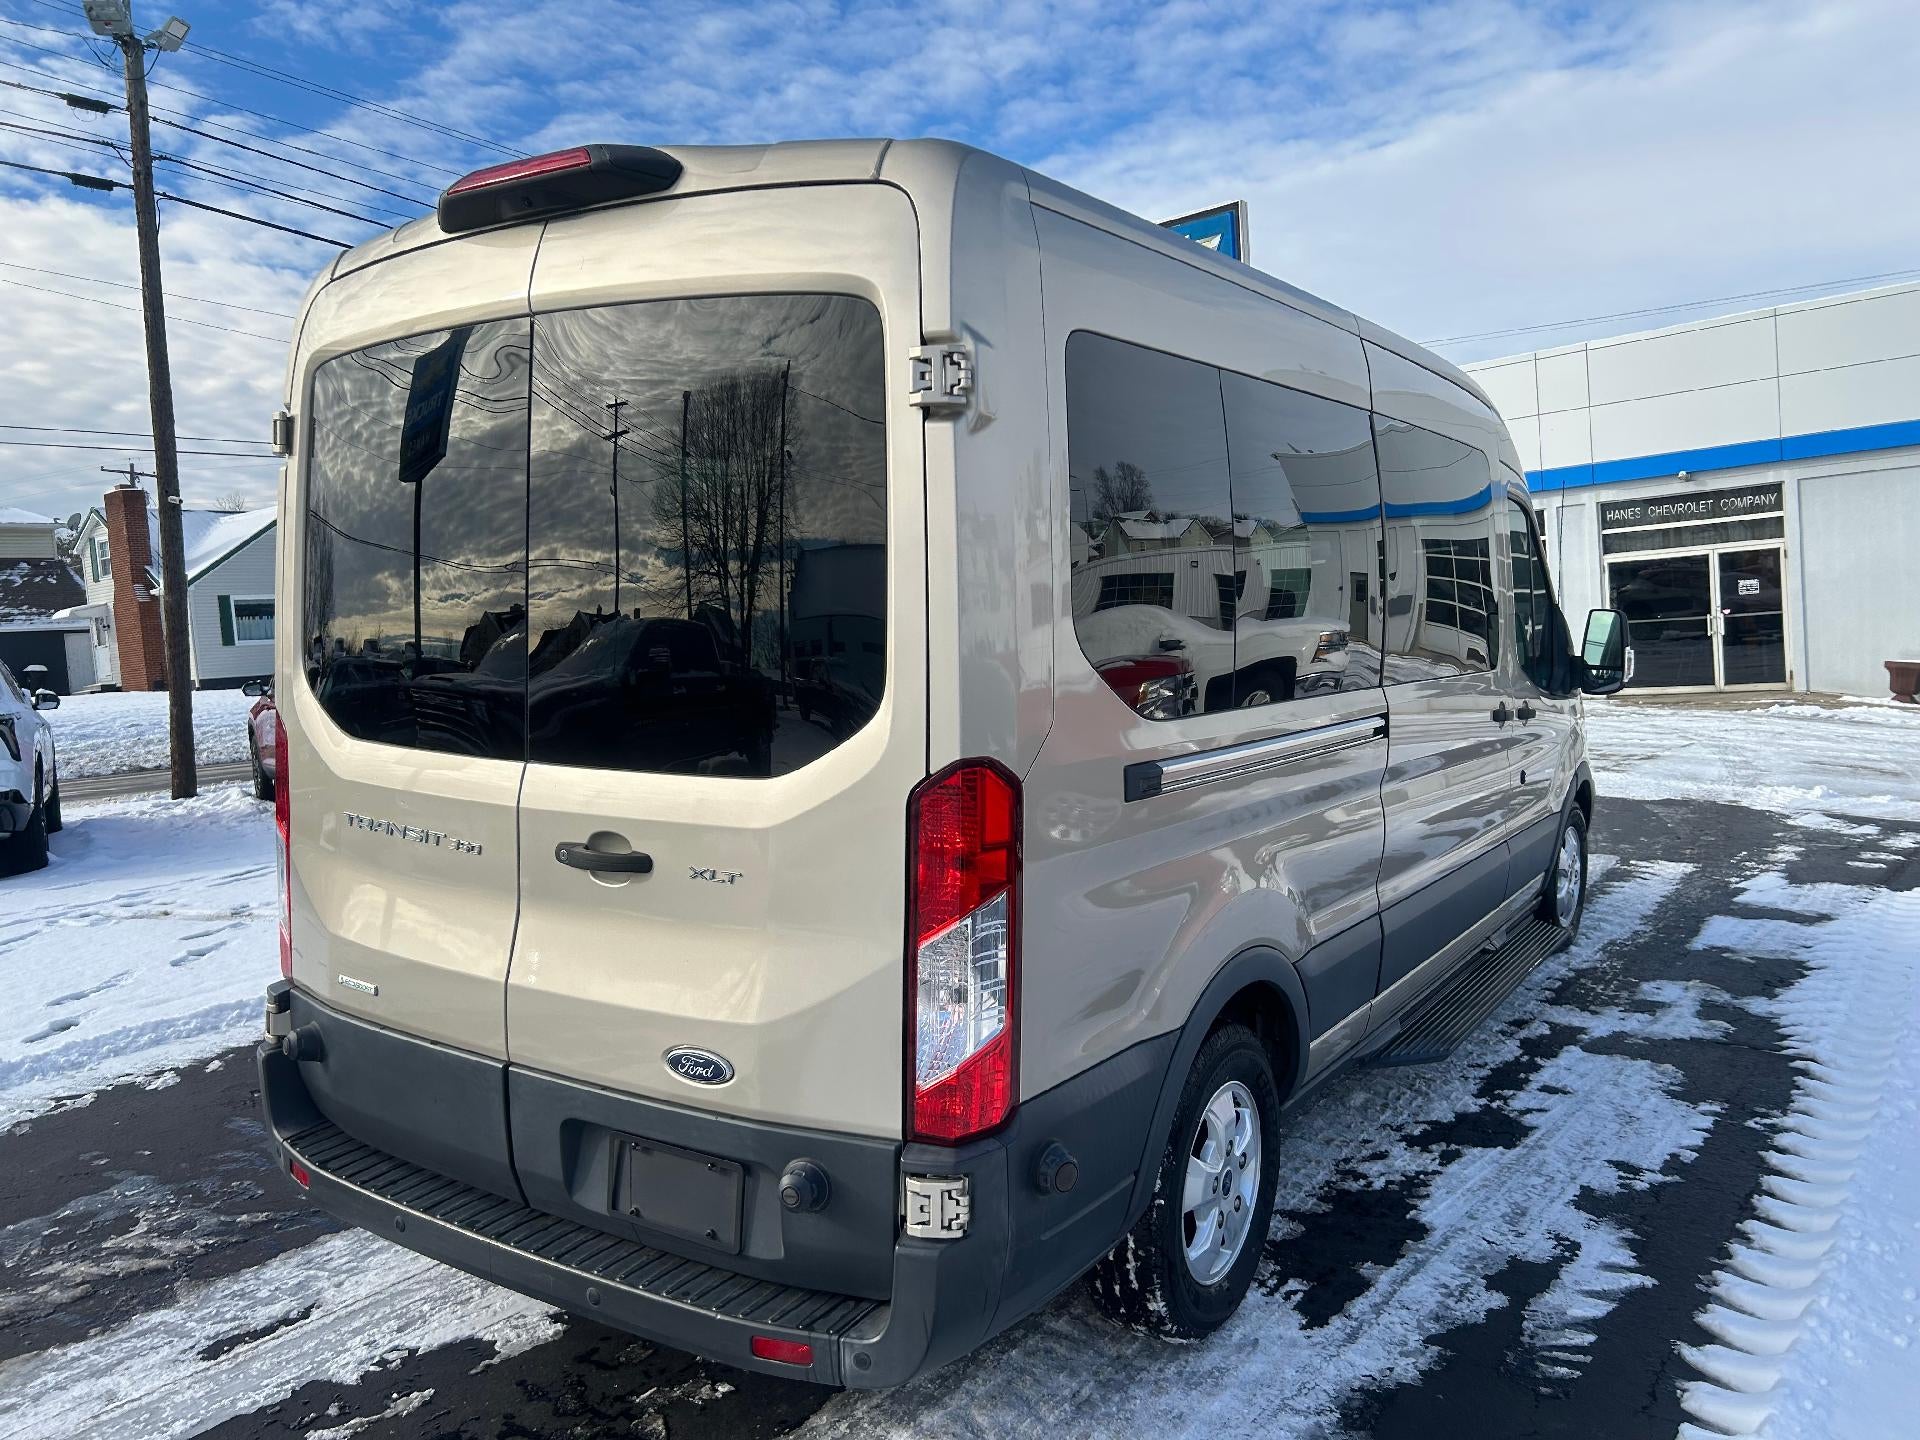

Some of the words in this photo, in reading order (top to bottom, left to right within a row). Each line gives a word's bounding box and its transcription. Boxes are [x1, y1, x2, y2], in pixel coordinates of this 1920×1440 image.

[1606, 507, 1641, 521] HANES
[1648, 500, 1713, 518] CHEVROLET
[1720, 493, 1778, 511] COMPANY
[343, 811, 447, 846] TRANSIT
[688, 865, 743, 885] XLT
[677, 1055, 717, 1078] Ford
